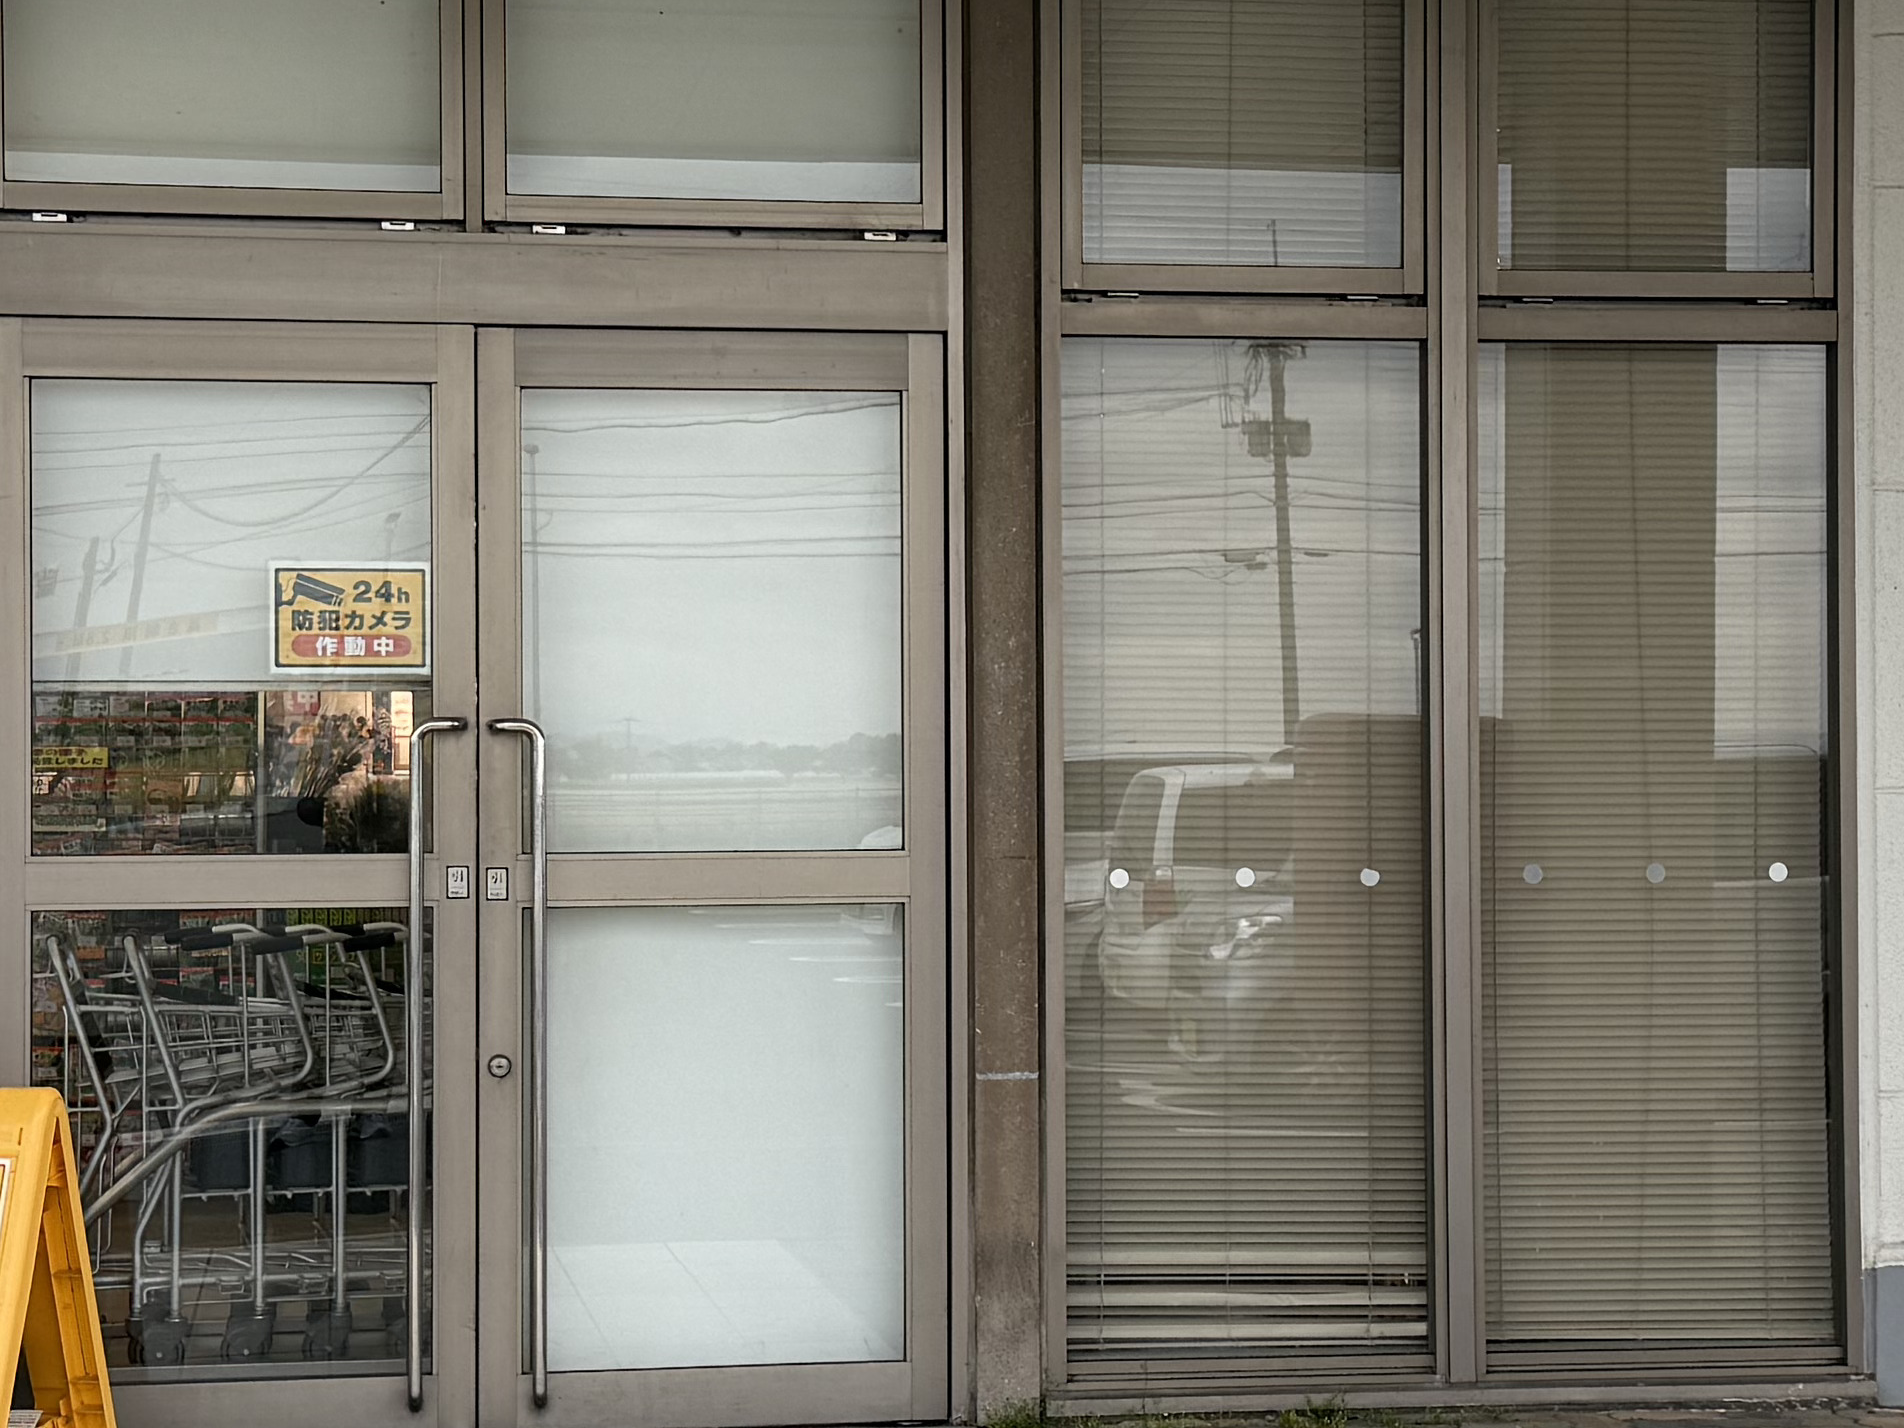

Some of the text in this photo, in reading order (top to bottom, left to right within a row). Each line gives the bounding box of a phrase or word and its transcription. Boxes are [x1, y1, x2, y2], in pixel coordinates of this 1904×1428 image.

[352, 580, 410, 604] 24h
[291, 609, 412, 632] 防犯カメラ
[315, 636, 394, 657] 作動中
